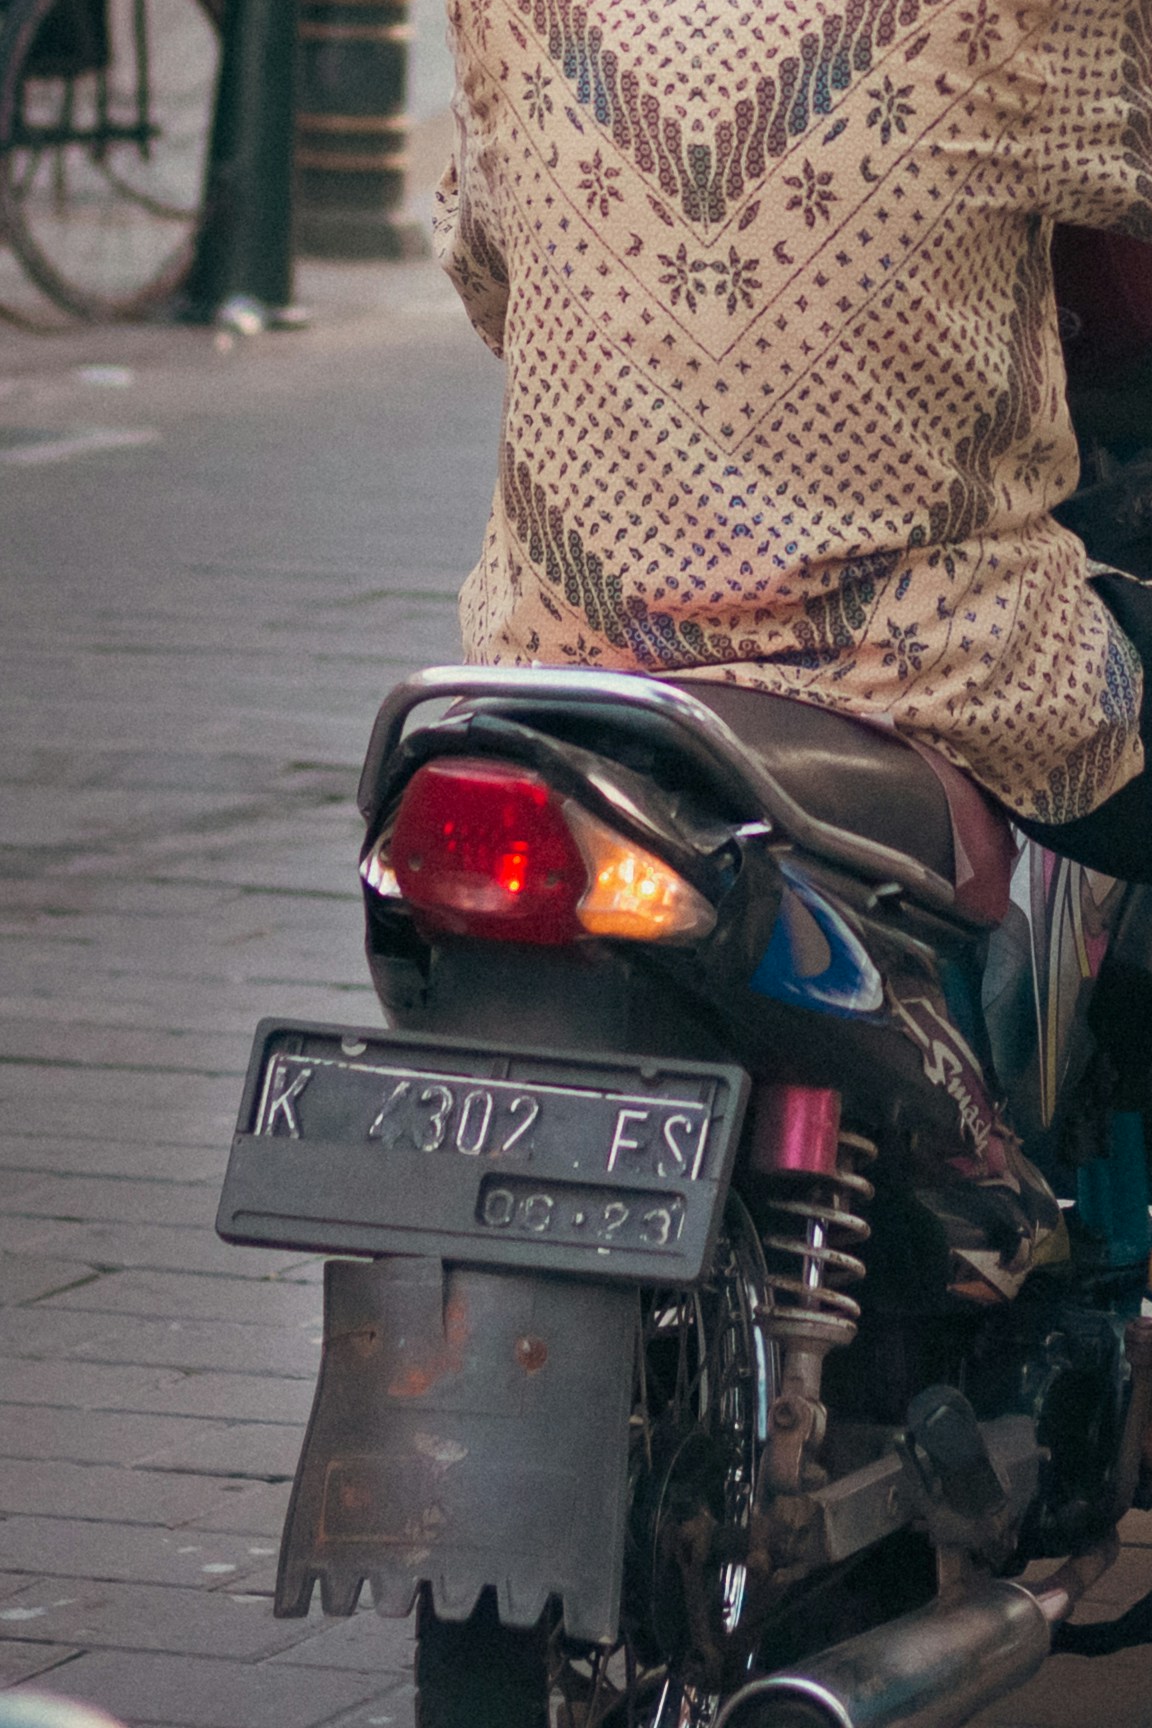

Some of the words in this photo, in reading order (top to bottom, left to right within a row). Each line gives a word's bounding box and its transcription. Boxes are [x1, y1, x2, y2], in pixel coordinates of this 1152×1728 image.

[265, 1066, 312, 1139] K
[607, 1109, 692, 1178] FS
[924, 1039, 993, 1159] Smash
